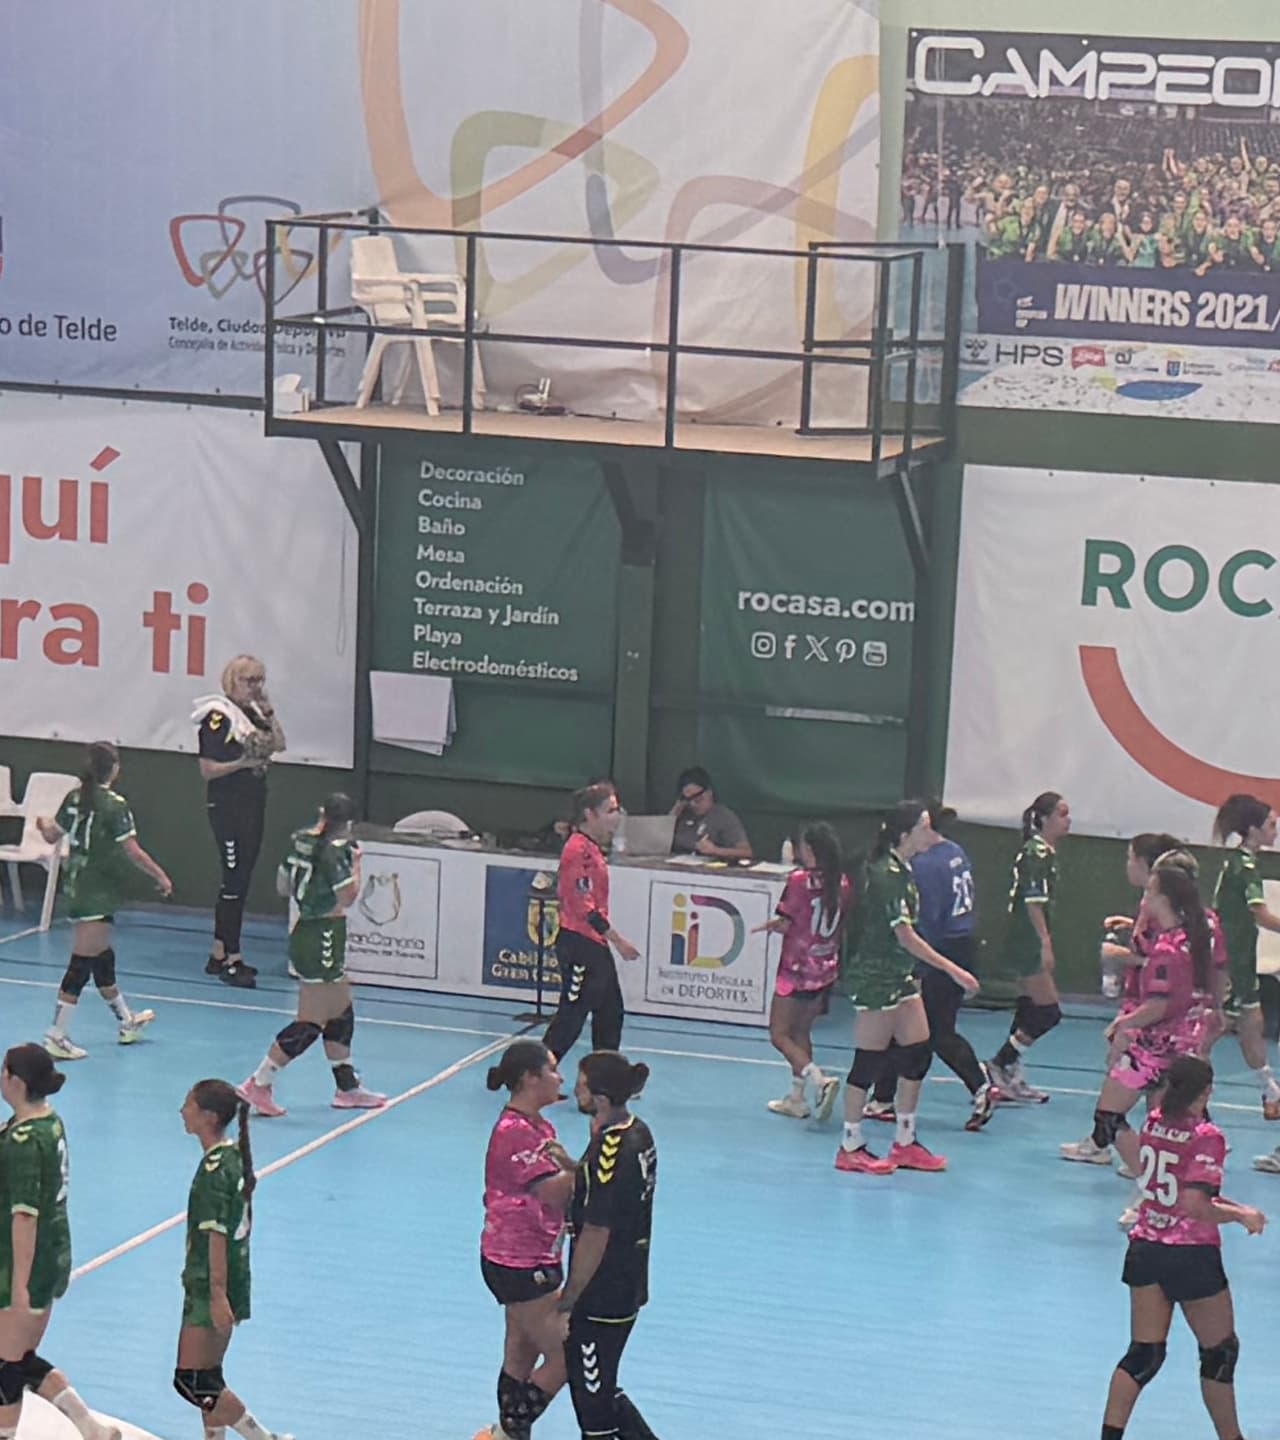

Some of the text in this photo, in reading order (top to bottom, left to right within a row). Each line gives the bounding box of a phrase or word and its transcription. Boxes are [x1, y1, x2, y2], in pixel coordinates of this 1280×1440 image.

[1054, 283, 1191, 328] WINNERS
[19, 313, 48, 337] de
[54, 314, 118, 342] Telde
[169, 317, 213, 334] Telde,
[217, 318, 266, 334] Ciuda
[995, 343, 1064, 367] HPS
[420, 461, 524, 486] Decoración
[418, 489, 482, 510] Cocina
[418, 516, 465, 535] Baño
[417, 544, 465, 563] Mesa
[416, 571, 523, 595] Ordenación
[414, 598, 559, 626] Terraza y Jardín
[738, 591, 915, 622] rocasa.com
[142, 582, 209, 677] ti
[414, 624, 462, 648] Playa
[413, 651, 578, 681] Electrodomésticos
[1137, 1144, 1180, 1207] 25
